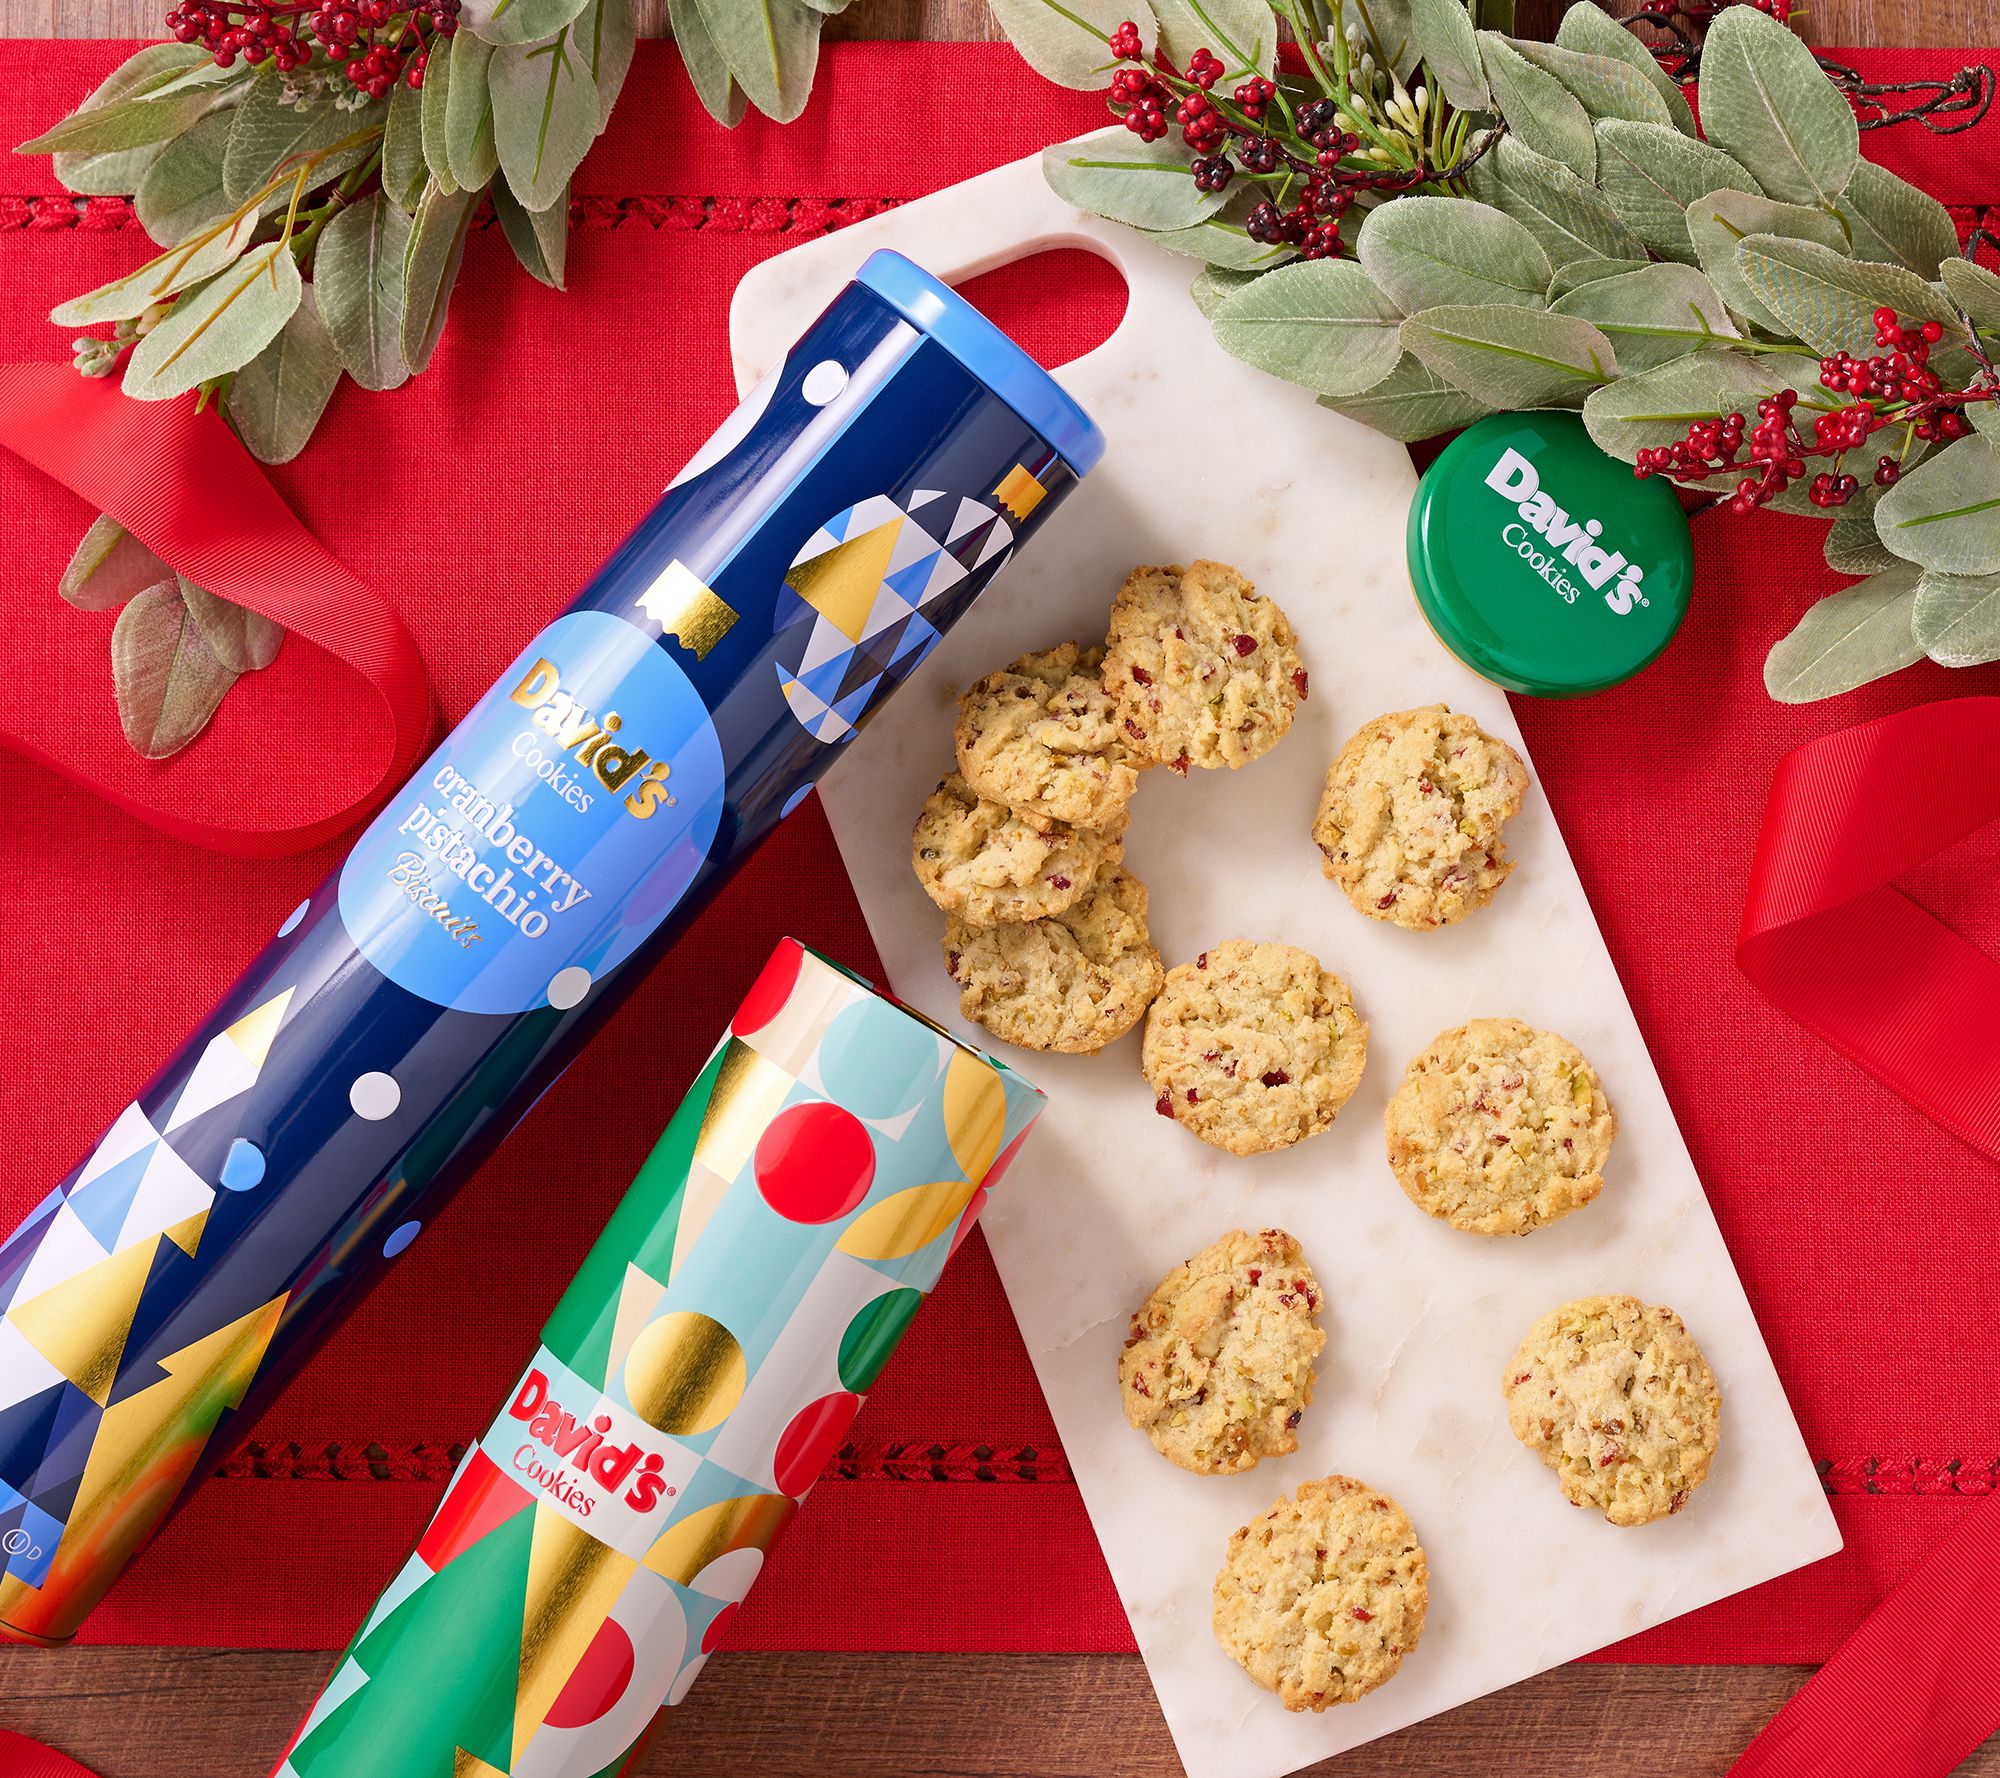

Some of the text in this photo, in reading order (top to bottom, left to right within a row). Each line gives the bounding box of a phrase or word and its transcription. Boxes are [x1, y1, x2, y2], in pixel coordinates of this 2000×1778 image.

[1502, 523, 1581, 604] Cookies
[511, 731, 594, 814] Cookies
[398, 802, 549, 939] pistachio
[432, 765, 592, 913] cranberry
[386, 851, 484, 949] Biscuits
[513, 1443, 596, 1517] Cookies
